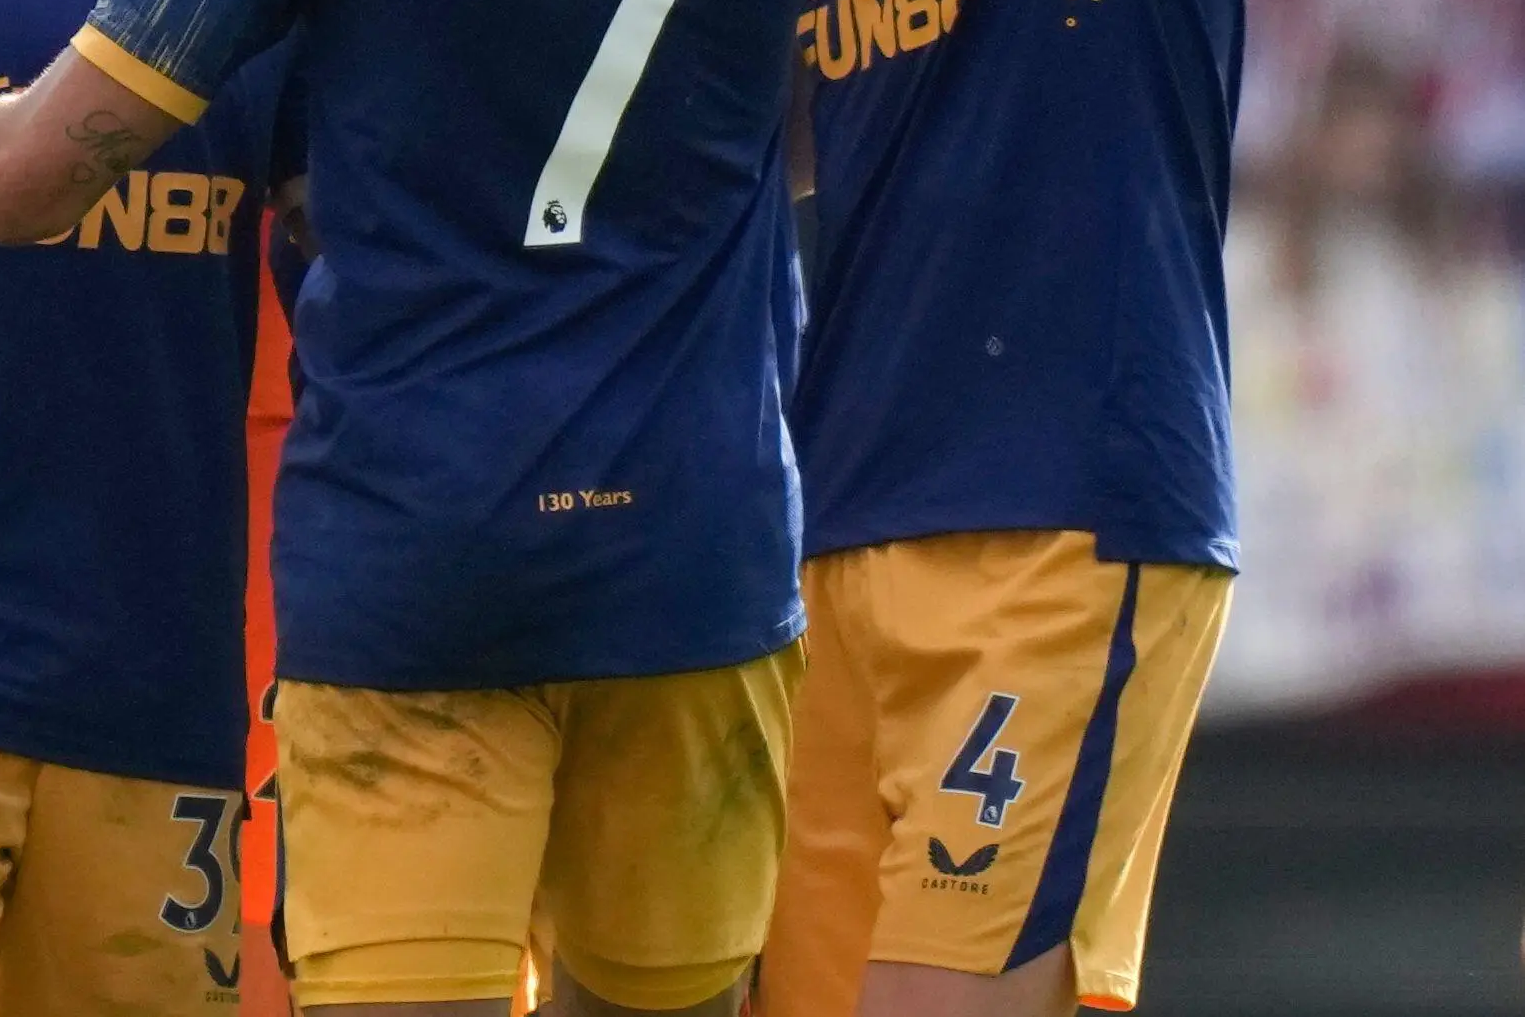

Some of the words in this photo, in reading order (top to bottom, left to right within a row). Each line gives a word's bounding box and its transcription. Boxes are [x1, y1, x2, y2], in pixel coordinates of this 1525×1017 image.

[538, 493, 574, 512] 130
[578, 489, 632, 509] Years
[938, 691, 1027, 829] 4
[159, 794, 242, 934] 3
[921, 878, 989, 895] CASTORE
